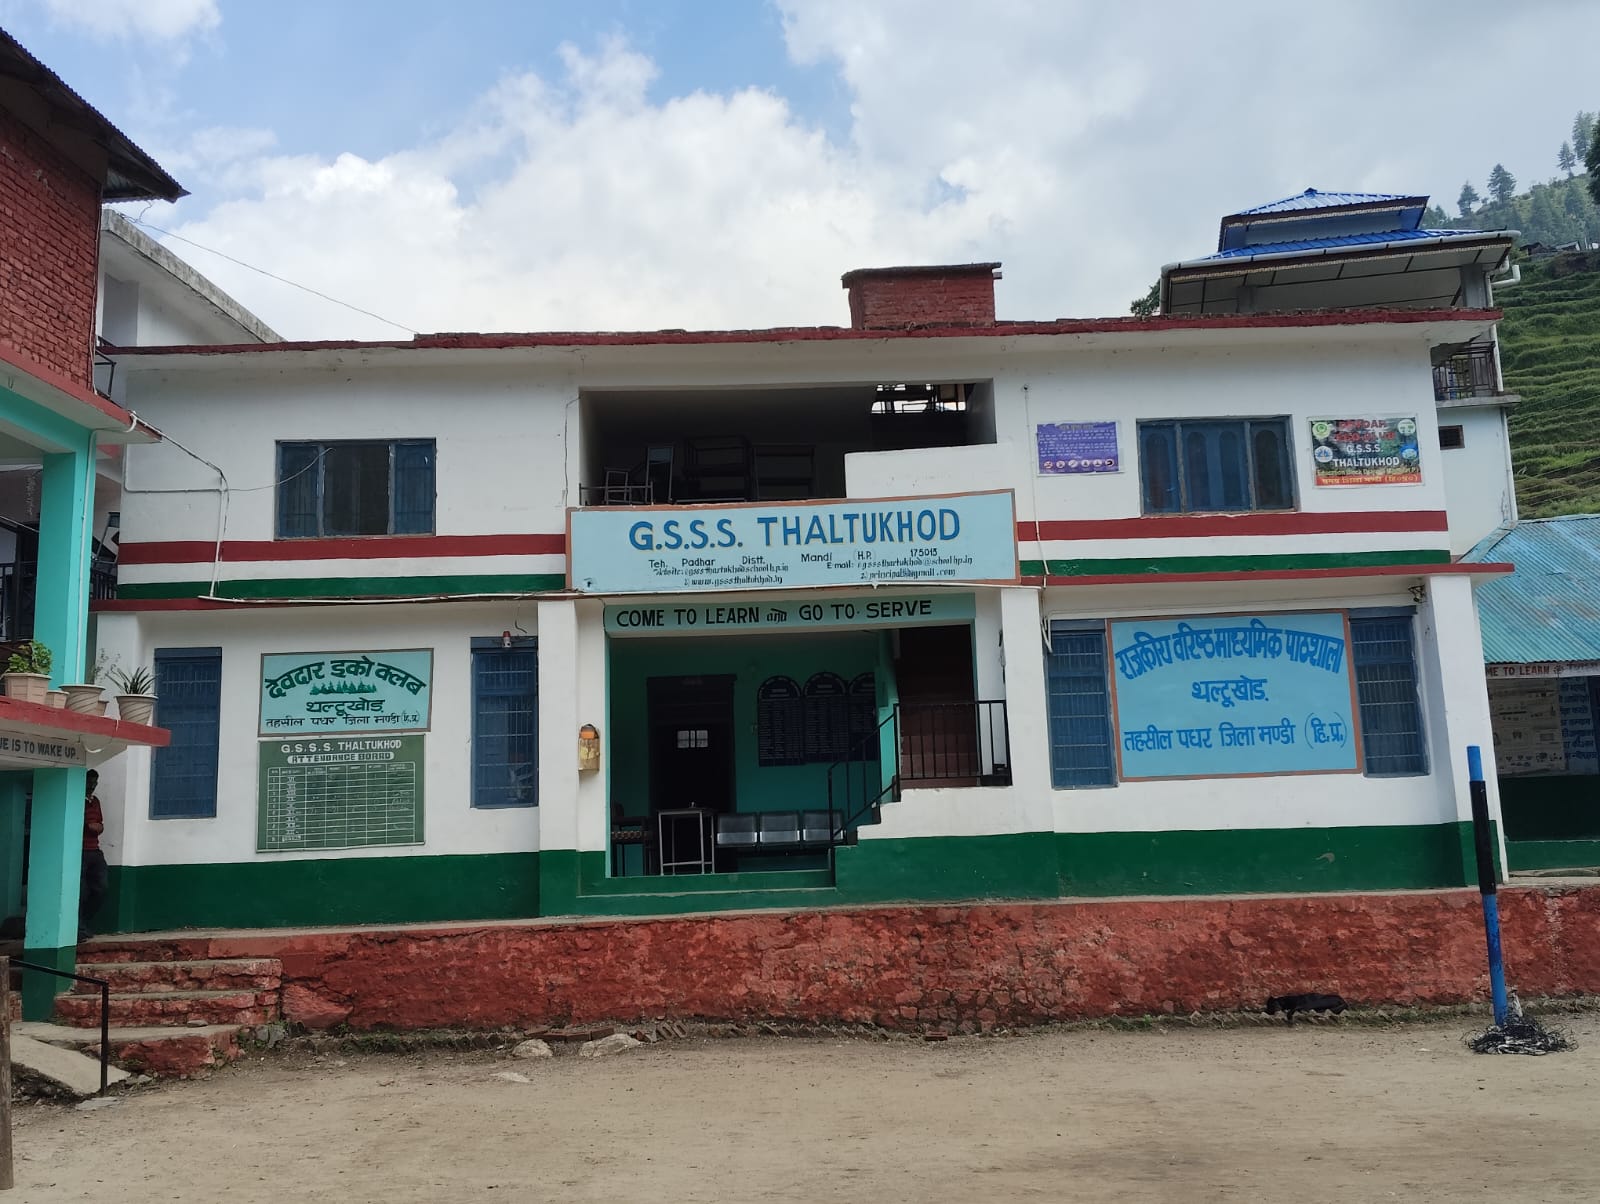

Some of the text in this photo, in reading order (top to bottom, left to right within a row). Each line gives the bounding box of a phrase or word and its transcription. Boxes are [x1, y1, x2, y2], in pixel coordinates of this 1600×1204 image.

[1346, 444, 1384, 453] G.S.S.S.
[1332, 456, 1400, 467] THALTUKHOD
[628, 508, 960, 551] G.S.S.S. THALTUKHOD
[648, 559, 668, 569] Teh.
[681, 557, 716, 568] Padhar
[742, 555, 766, 565] Distt.
[801, 552, 833, 562] Mandi
[857, 550, 872, 561] H.P.
[616, 609, 665, 627] COME
[673, 608, 697, 625] TO
[705, 607, 760, 624] LEARN
[798, 604, 823, 621] GO
[866, 600, 932, 618] SERVE
[1114, 631, 1173, 680] राजकीय
[1172, 622, 1214, 662] वरिष्ठ
[1284, 629, 1345, 674] पाठशाला
[265, 655, 427, 699] देवदार इको क्लब
[1503, 666, 1516, 676] TO
[1519, 665, 1550, 676] LEARN
[265, 714, 306, 729] तहसील
[342, 713, 371, 726] जिला
[1124, 724, 1174, 752] तहसील
[1218, 721, 1256, 747] जिला
[1257, 717, 1297, 745] मण्डी
[11, 738, 21, 752] IS
[23, 740, 35, 754] TO
[37, 742, 62, 757] WAKE
[281, 739, 402, 753] G.S.S.S. THALTUKHOD
